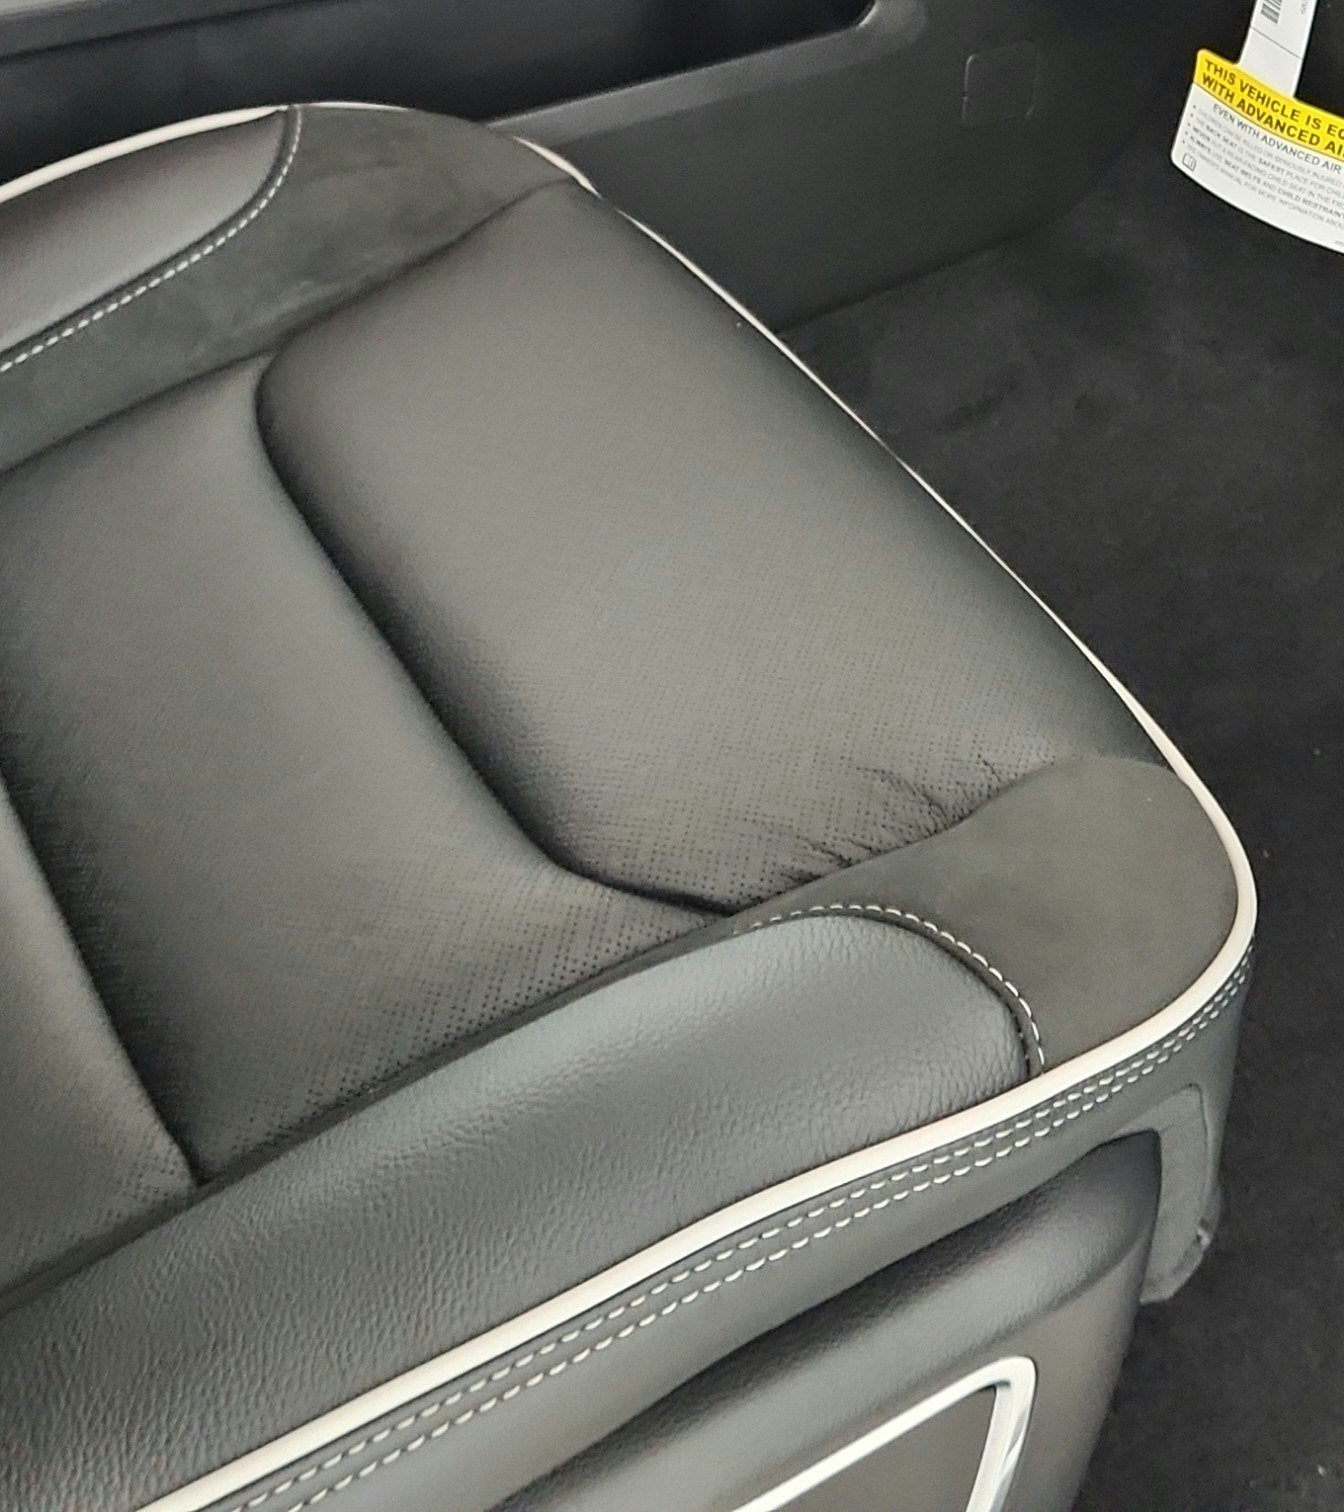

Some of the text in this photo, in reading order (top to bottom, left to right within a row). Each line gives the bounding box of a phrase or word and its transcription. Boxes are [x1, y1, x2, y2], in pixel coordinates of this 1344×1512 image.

[1203, 73, 1235, 103] WITH
[1236, 98, 1321, 146] ADVANCED
[1205, 59, 1236, 85] THIS
[1240, 79, 1301, 122] VEHICLE
[1305, 115, 1322, 130] IS
[1213, 103, 1235, 123] EVEN
[1237, 118, 1260, 138] WITH
[1261, 135, 1320, 165] ADVANCED
[1322, 160, 1342, 175] AIR
